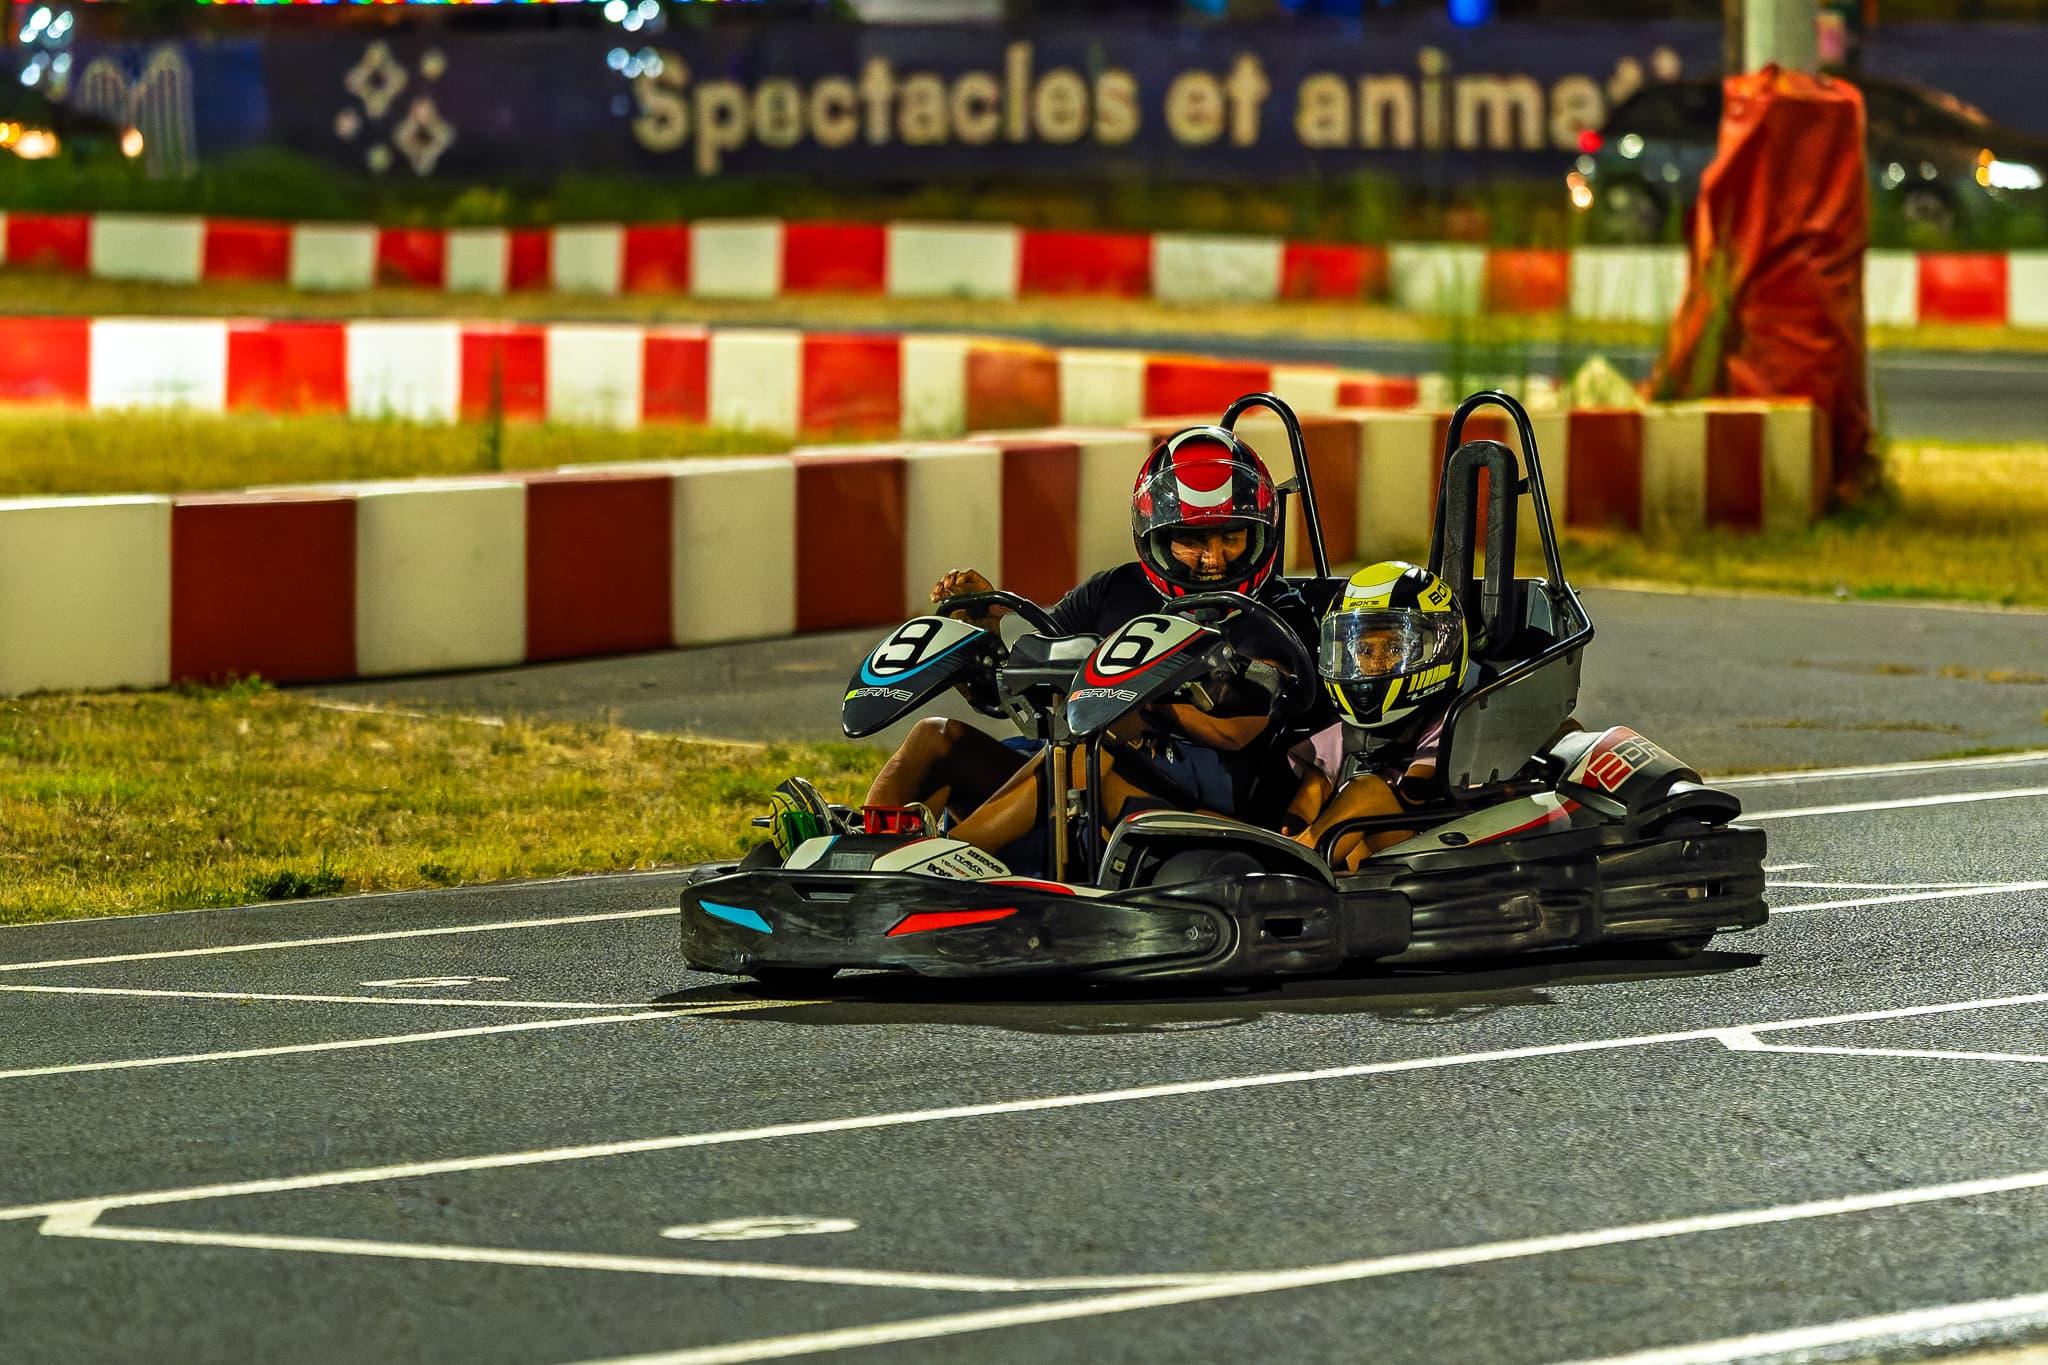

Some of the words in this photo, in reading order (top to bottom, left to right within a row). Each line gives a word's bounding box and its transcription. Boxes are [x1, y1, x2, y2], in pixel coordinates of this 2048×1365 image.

[632, 40, 1141, 176] Spectacles
[1166, 51, 1270, 147] et
[877, 618, 943, 670] 9
[1101, 617, 1172, 668] 6
